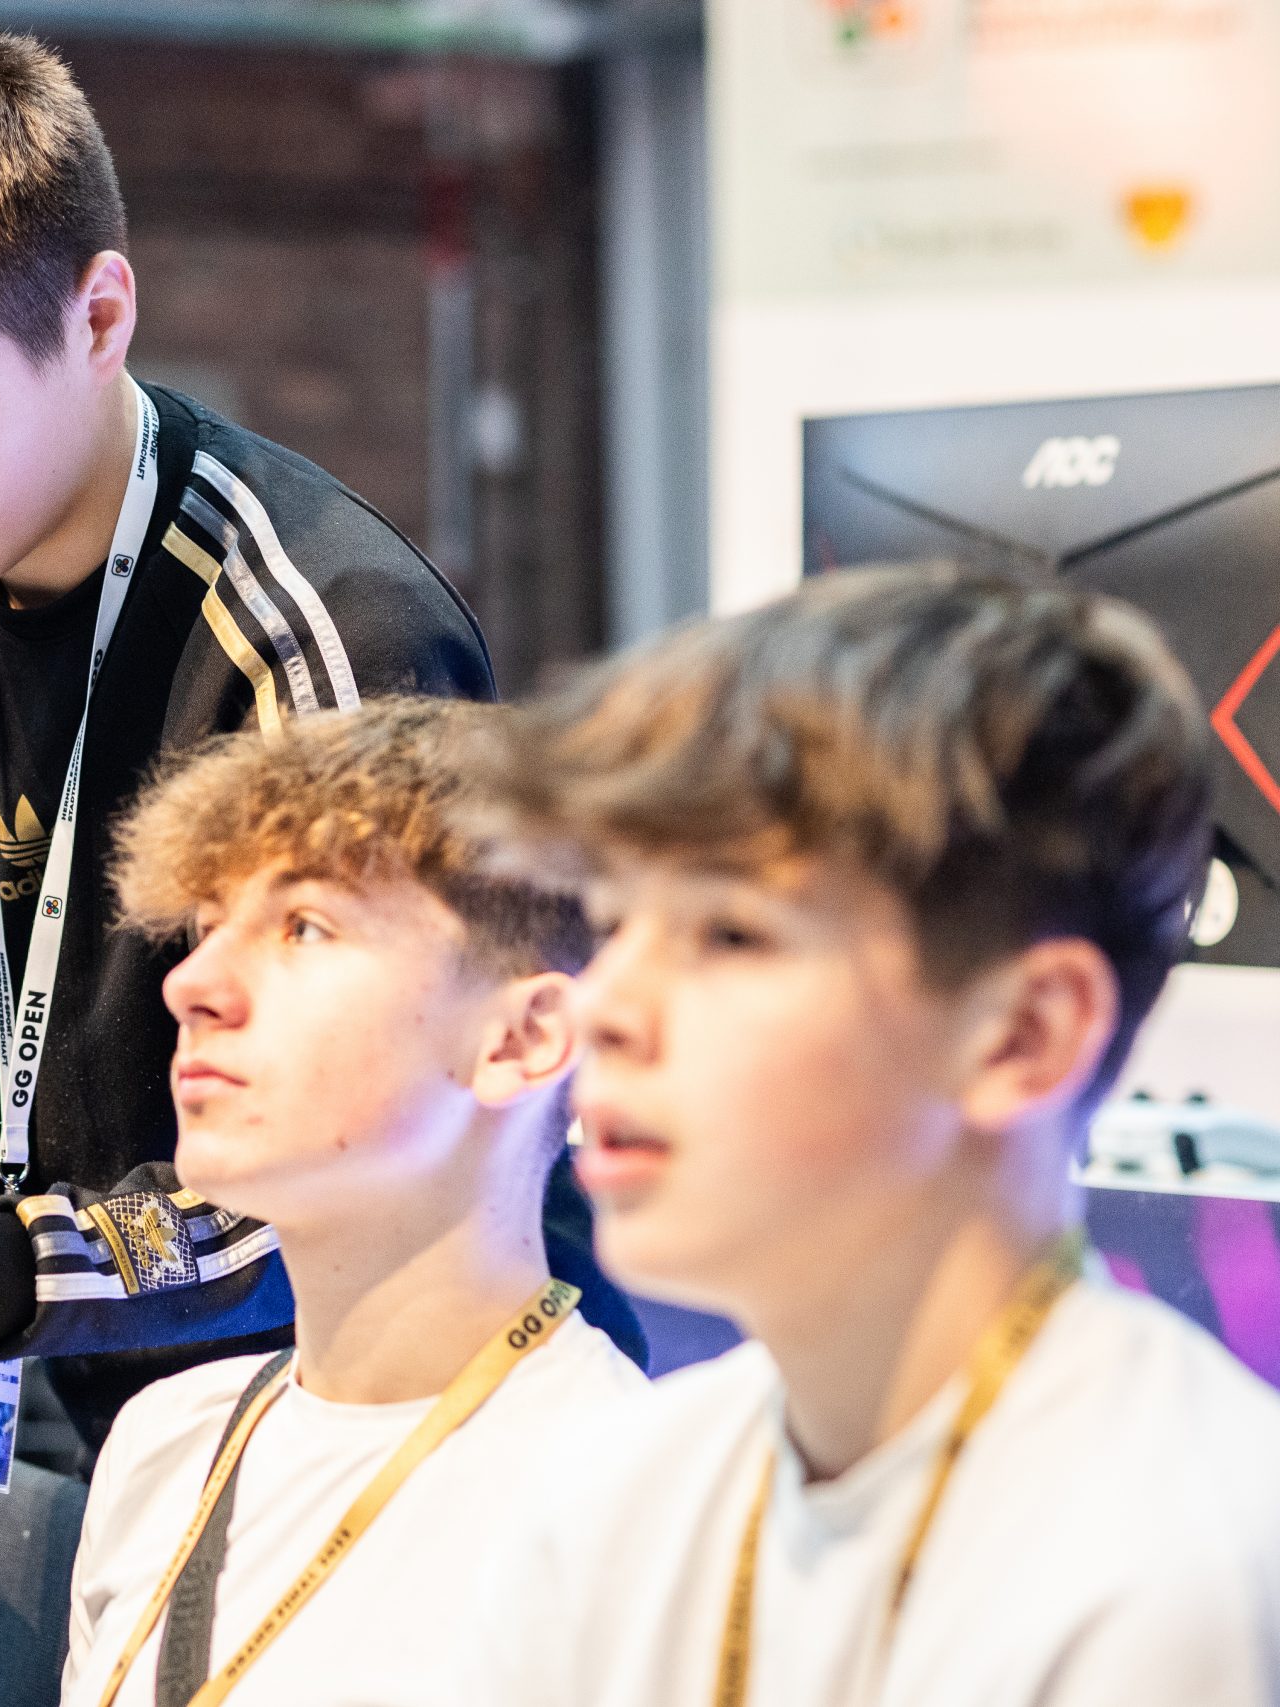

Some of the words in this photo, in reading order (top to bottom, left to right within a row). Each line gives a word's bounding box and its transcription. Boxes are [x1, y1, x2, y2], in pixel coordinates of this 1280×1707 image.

[0, 870, 41, 901] adi
[19, 990, 47, 1062] OPEN
[12, 1069, 33, 1108] GG
